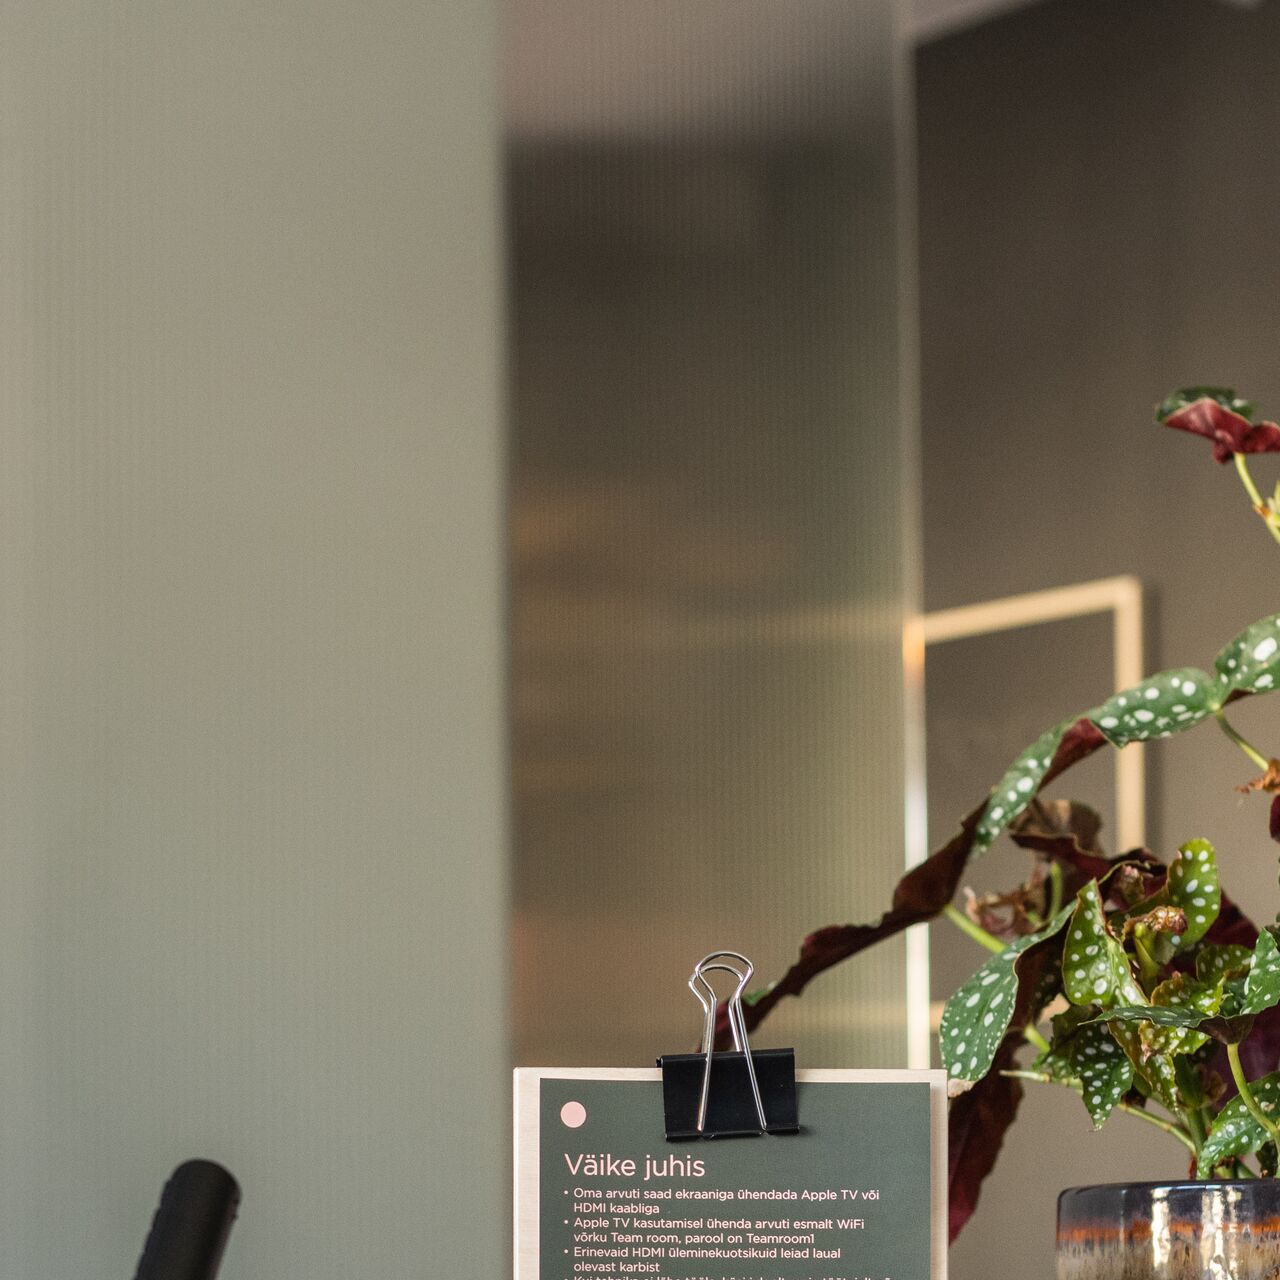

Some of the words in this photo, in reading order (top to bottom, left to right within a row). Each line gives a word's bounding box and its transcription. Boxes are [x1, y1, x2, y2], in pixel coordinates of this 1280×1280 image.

[563, 1152, 637, 1177] Väike
[643, 1153, 706, 1181] juhis
[573, 1187, 603, 1199] Oma
[605, 1188, 641, 1199] arvuti
[643, 1188, 672, 1200] saad
[674, 1188, 735, 1202] ekraaniga
[737, 1188, 798, 1201] ühendada
[800, 1188, 838, 1202] Apple
[840, 1189, 859, 1201] TV
[861, 1189, 880, 1201] või
[573, 1202, 607, 1213] HDMI
[609, 1202, 660, 1216] kaabliga
[573, 1216, 610, 1230] Apple
[612, 1217, 631, 1228] TV
[633, 1217, 704, 1229] kasutamisel
[706, 1217, 752, 1230] ühenda
[754, 1218, 790, 1230] arvuti
[792, 1218, 834, 1230] esmalt
[836, 1218, 865, 1230] WiFi
[573, 1231, 608, 1243] võrku
[610, 1231, 644, 1243] Team
[646, 1234, 682, 1245] room,
[684, 1232, 724, 1246] parool
[726, 1235, 743, 1244] on
[745, 1232, 815, 1244] Teamroom1
[573, 1246, 629, 1258] Erinevaid
[632, 1247, 665, 1258] HDMI
[668, 1246, 778, 1259] üleminekuotsikuid
[780, 1247, 810, 1259] leiad
[812, 1247, 841, 1259] laual
[573, 1260, 617, 1272] olevast
[619, 1261, 661, 1273] karbist
